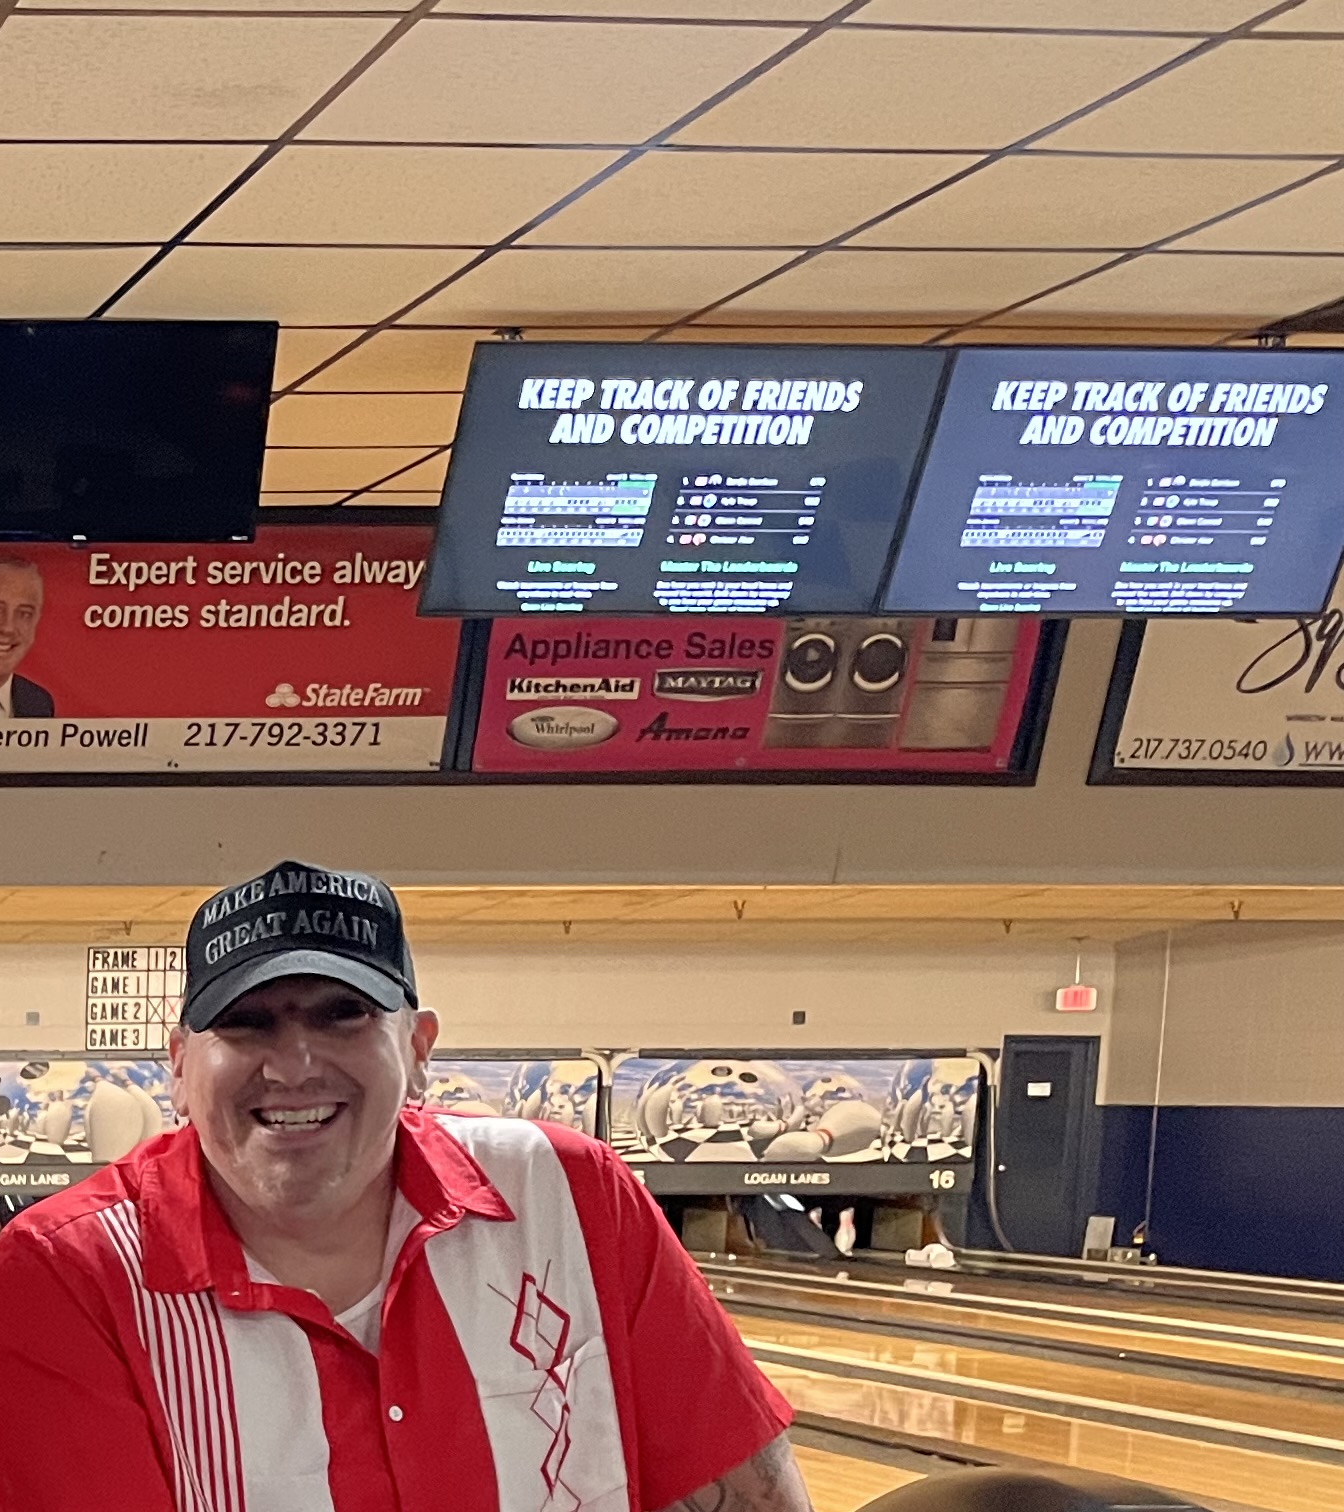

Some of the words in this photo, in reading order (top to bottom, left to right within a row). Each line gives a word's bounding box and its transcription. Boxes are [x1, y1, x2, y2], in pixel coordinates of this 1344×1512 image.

[519, 378, 595, 410] KEEP
[600, 379, 694, 411] TRACK
[698, 380, 739, 411] OF
[741, 380, 864, 412] FRIENDS
[992, 380, 1068, 411] KEEP
[1071, 381, 1166, 413] TRACK
[1167, 382, 1210, 413] OF
[1208, 383, 1329, 415] FRIENDS
[549, 414, 614, 444] AND
[619, 415, 815, 446] COMPETITION
[1020, 415, 1085, 446] AND
[1088, 416, 1278, 447] COMPETITION
[88, 553, 197, 591] Expert
[206, 553, 322, 586] service
[333, 552, 428, 590] alway
[83, 602, 189, 628] comes
[200, 596, 350, 628] standard.
[504, 631, 674, 666] Appliance
[685, 631, 775, 661] Sales
[509, 677, 635, 695] KitchenAid
[665, 676, 752, 689] MAYTAG
[61, 723, 148, 748] Powell
[183, 722, 383, 748] 217-792-3371
[534, 721, 596, 738] Whirlpool
[635, 711, 750, 743] Amana
[1129, 738, 1268, 762] 217.737.0540
[201, 879, 265, 930] MAKE
[269, 869, 384, 908] AMERICA
[204, 911, 286, 965] GREAT
[292, 909, 379, 949] AGAIN
[92, 950, 138, 969] FRAME
[154, 950, 160, 969] 1
[169, 951, 178, 970] 2
[91, 976, 129, 994] GAME
[136, 976, 141, 994] 1
[90, 1002, 129, 1020] GAME
[133, 1002, 141, 1020] 2
[89, 1028, 128, 1047] GAME
[132, 1028, 140, 1046] 3
[30, 1174, 70, 1186] LANES
[744, 1173, 786, 1185] LOGAN
[790, 1173, 830, 1185] LANES
[929, 1169, 956, 1189] 16
